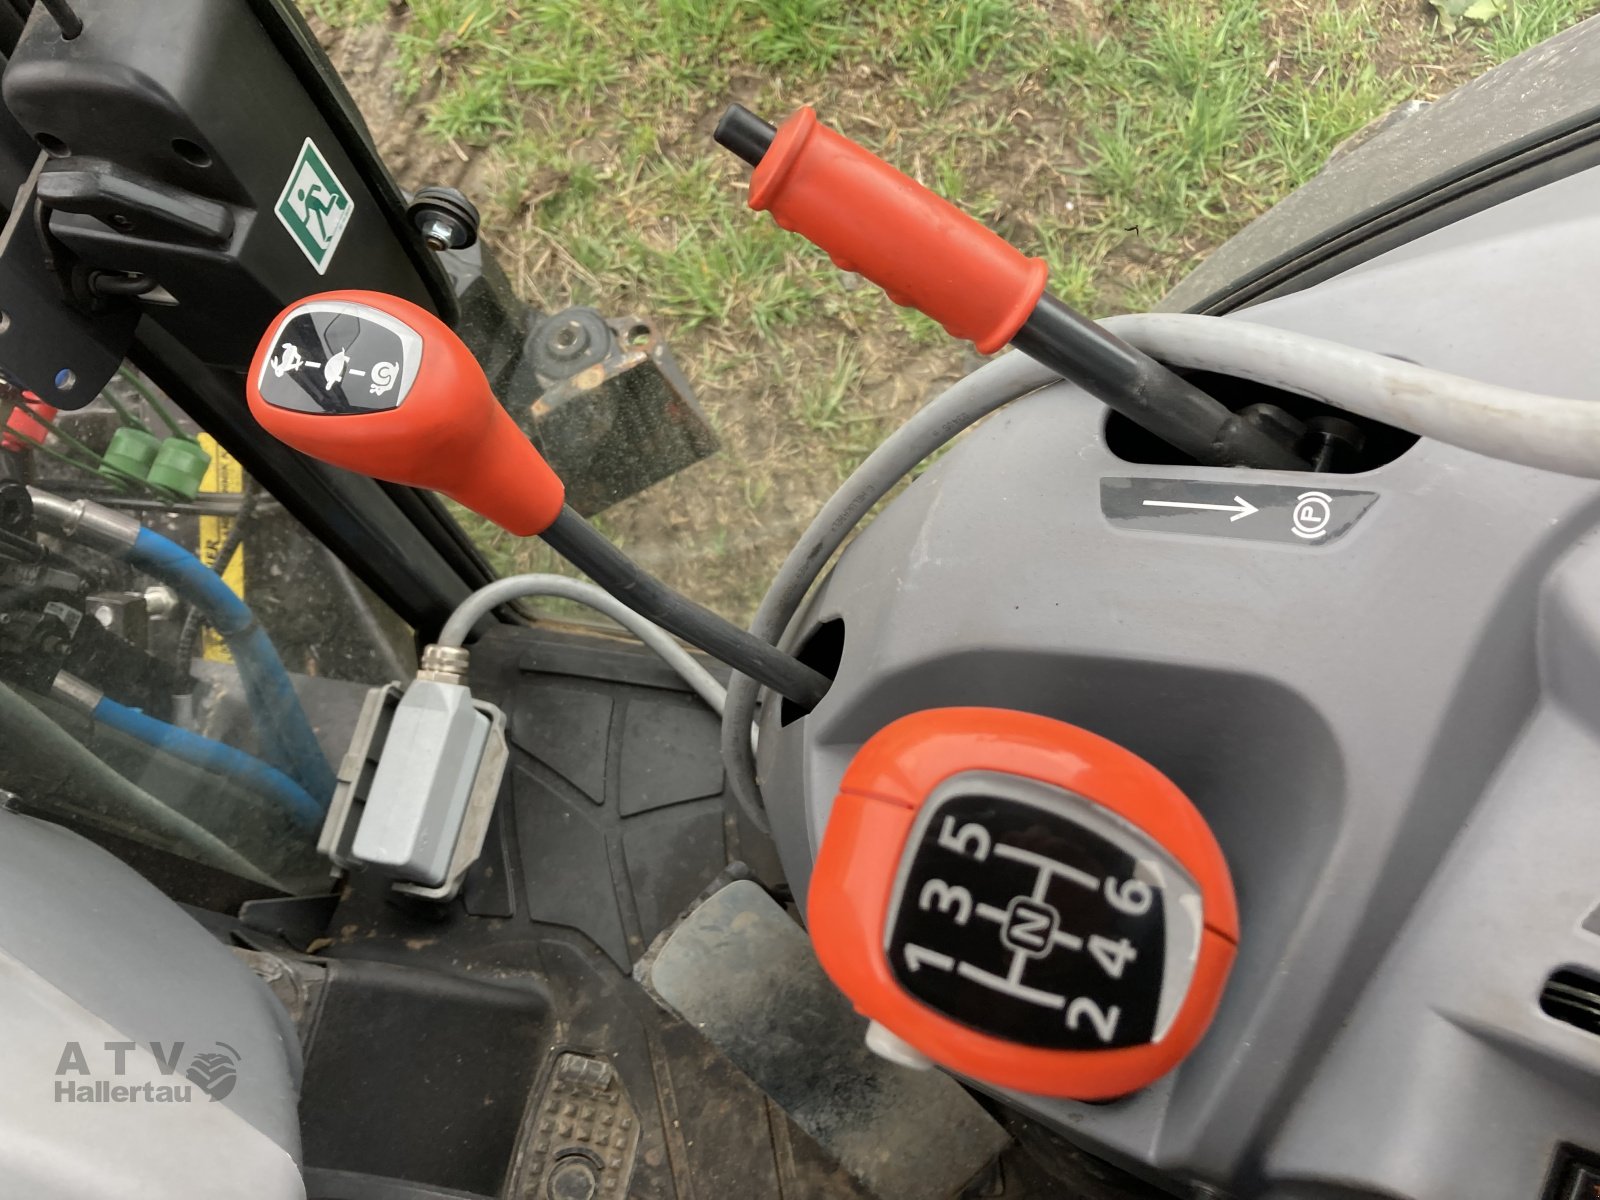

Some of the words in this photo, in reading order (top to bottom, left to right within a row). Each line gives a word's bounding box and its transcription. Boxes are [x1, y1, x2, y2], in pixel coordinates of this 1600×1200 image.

[1300, 505, 1321, 522] P
[937, 815, 991, 862] 5
[919, 878, 973, 925] 3
[1104, 876, 1152, 916] 6
[1009, 906, 1050, 948] N
[904, 942, 956, 973] 1
[1087, 934, 1138, 979] 4
[1065, 997, 1121, 1042] 2
